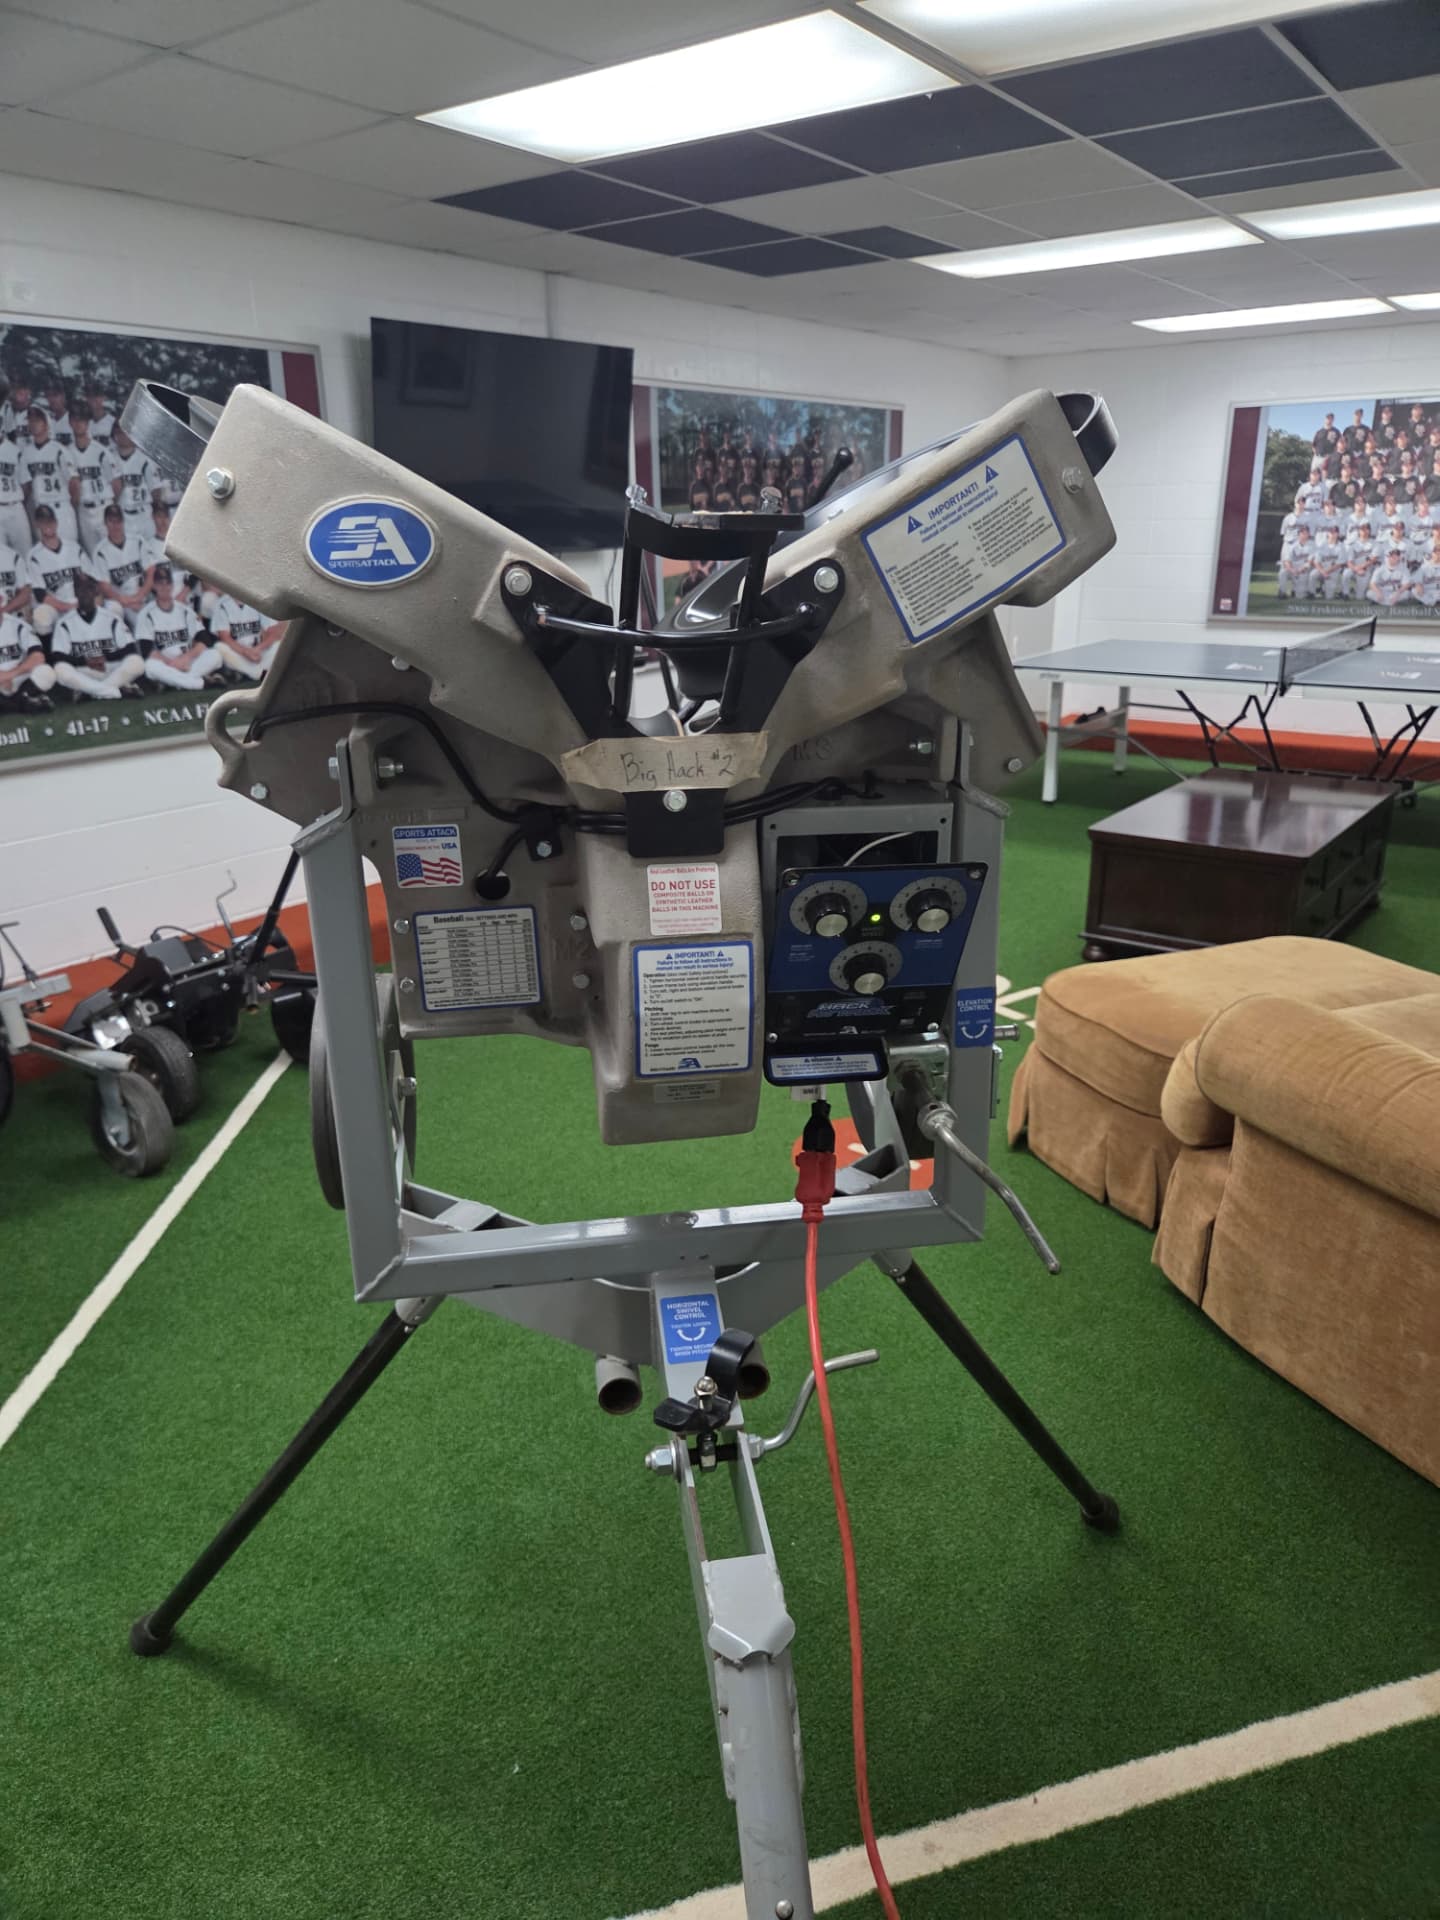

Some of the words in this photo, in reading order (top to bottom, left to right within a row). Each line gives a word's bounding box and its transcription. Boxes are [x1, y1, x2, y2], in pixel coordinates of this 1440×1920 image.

[928, 481, 979, 520] IMPORTANT!
[66, 716, 110, 737] 41-17
[144, 706, 193, 726] NCAA
[620, 751, 657, 788] Big
[395, 829, 426, 839] SPORTS
[427, 827, 456, 837] ATTACK
[441, 842, 458, 850] USA
[651, 881, 666, 891] DO
[669, 880, 691, 890] NOT
[695, 879, 716, 889] USE
[433, 913, 465, 924] Baseball
[674, 951, 716, 959] IMPORTANT!
[957, 998, 993, 1007] ELEVATION
[667, 1300, 710, 1310] HORIZONTAL
[676, 1306, 702, 1314] SWIVEL
[674, 1312, 706, 1321] CONTROL
